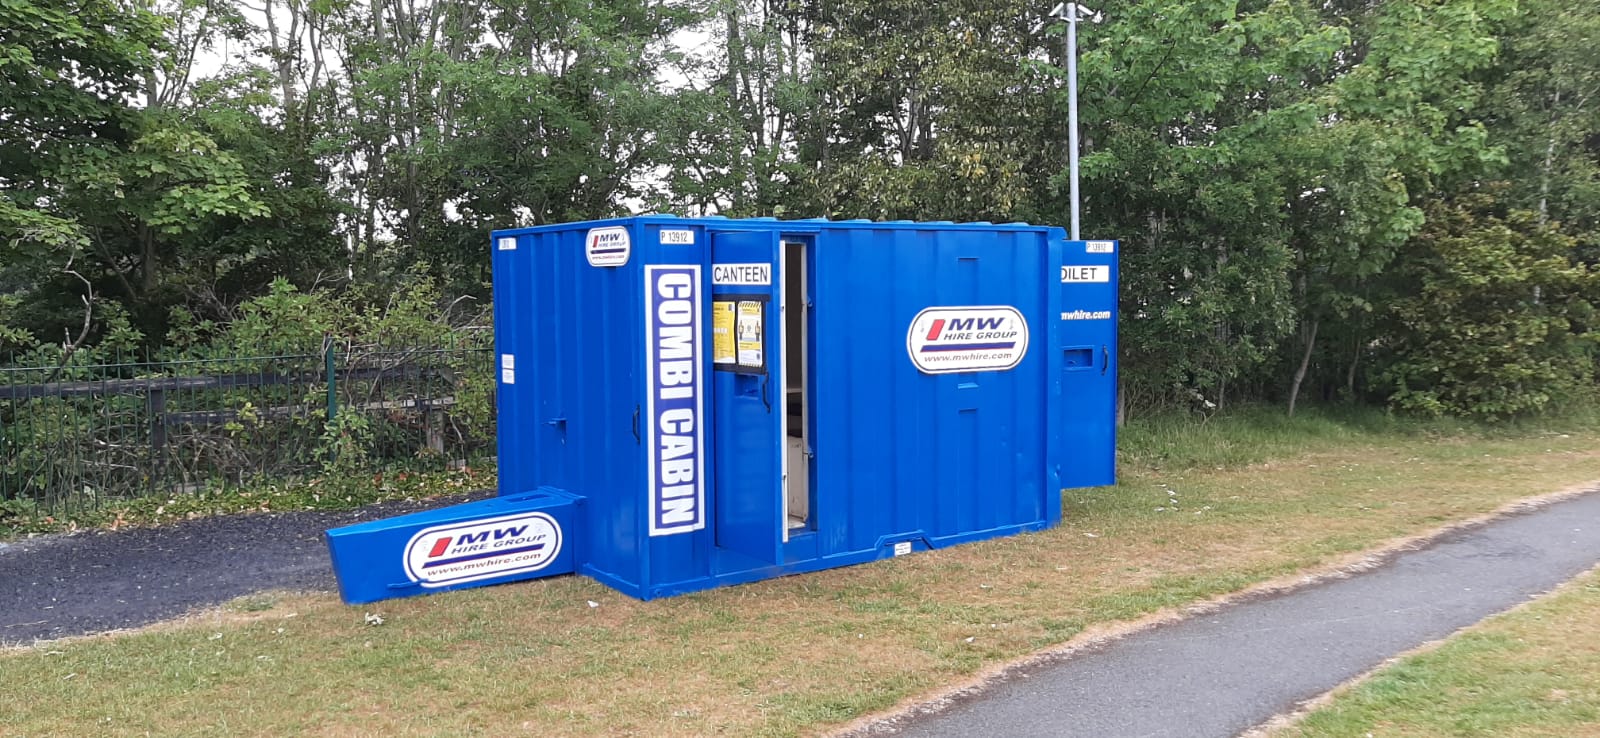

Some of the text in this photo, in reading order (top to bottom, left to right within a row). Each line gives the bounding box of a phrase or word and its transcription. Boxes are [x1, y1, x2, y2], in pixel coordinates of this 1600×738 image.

[600, 233, 620, 242] MW
[661, 231, 688, 243] P 13912
[714, 266, 768, 282] CANTEEN
[948, 317, 1006, 331] MW
[943, 331, 1018, 341] HIRE GROUP
[924, 352, 1012, 362] www.mwhire.com
[657, 273, 695, 525] COMBI CABIN
[456, 524, 529, 546] MW
[451, 534, 547, 554] HIRE GROUP
[427, 553, 541, 576] www.mwhire.com
